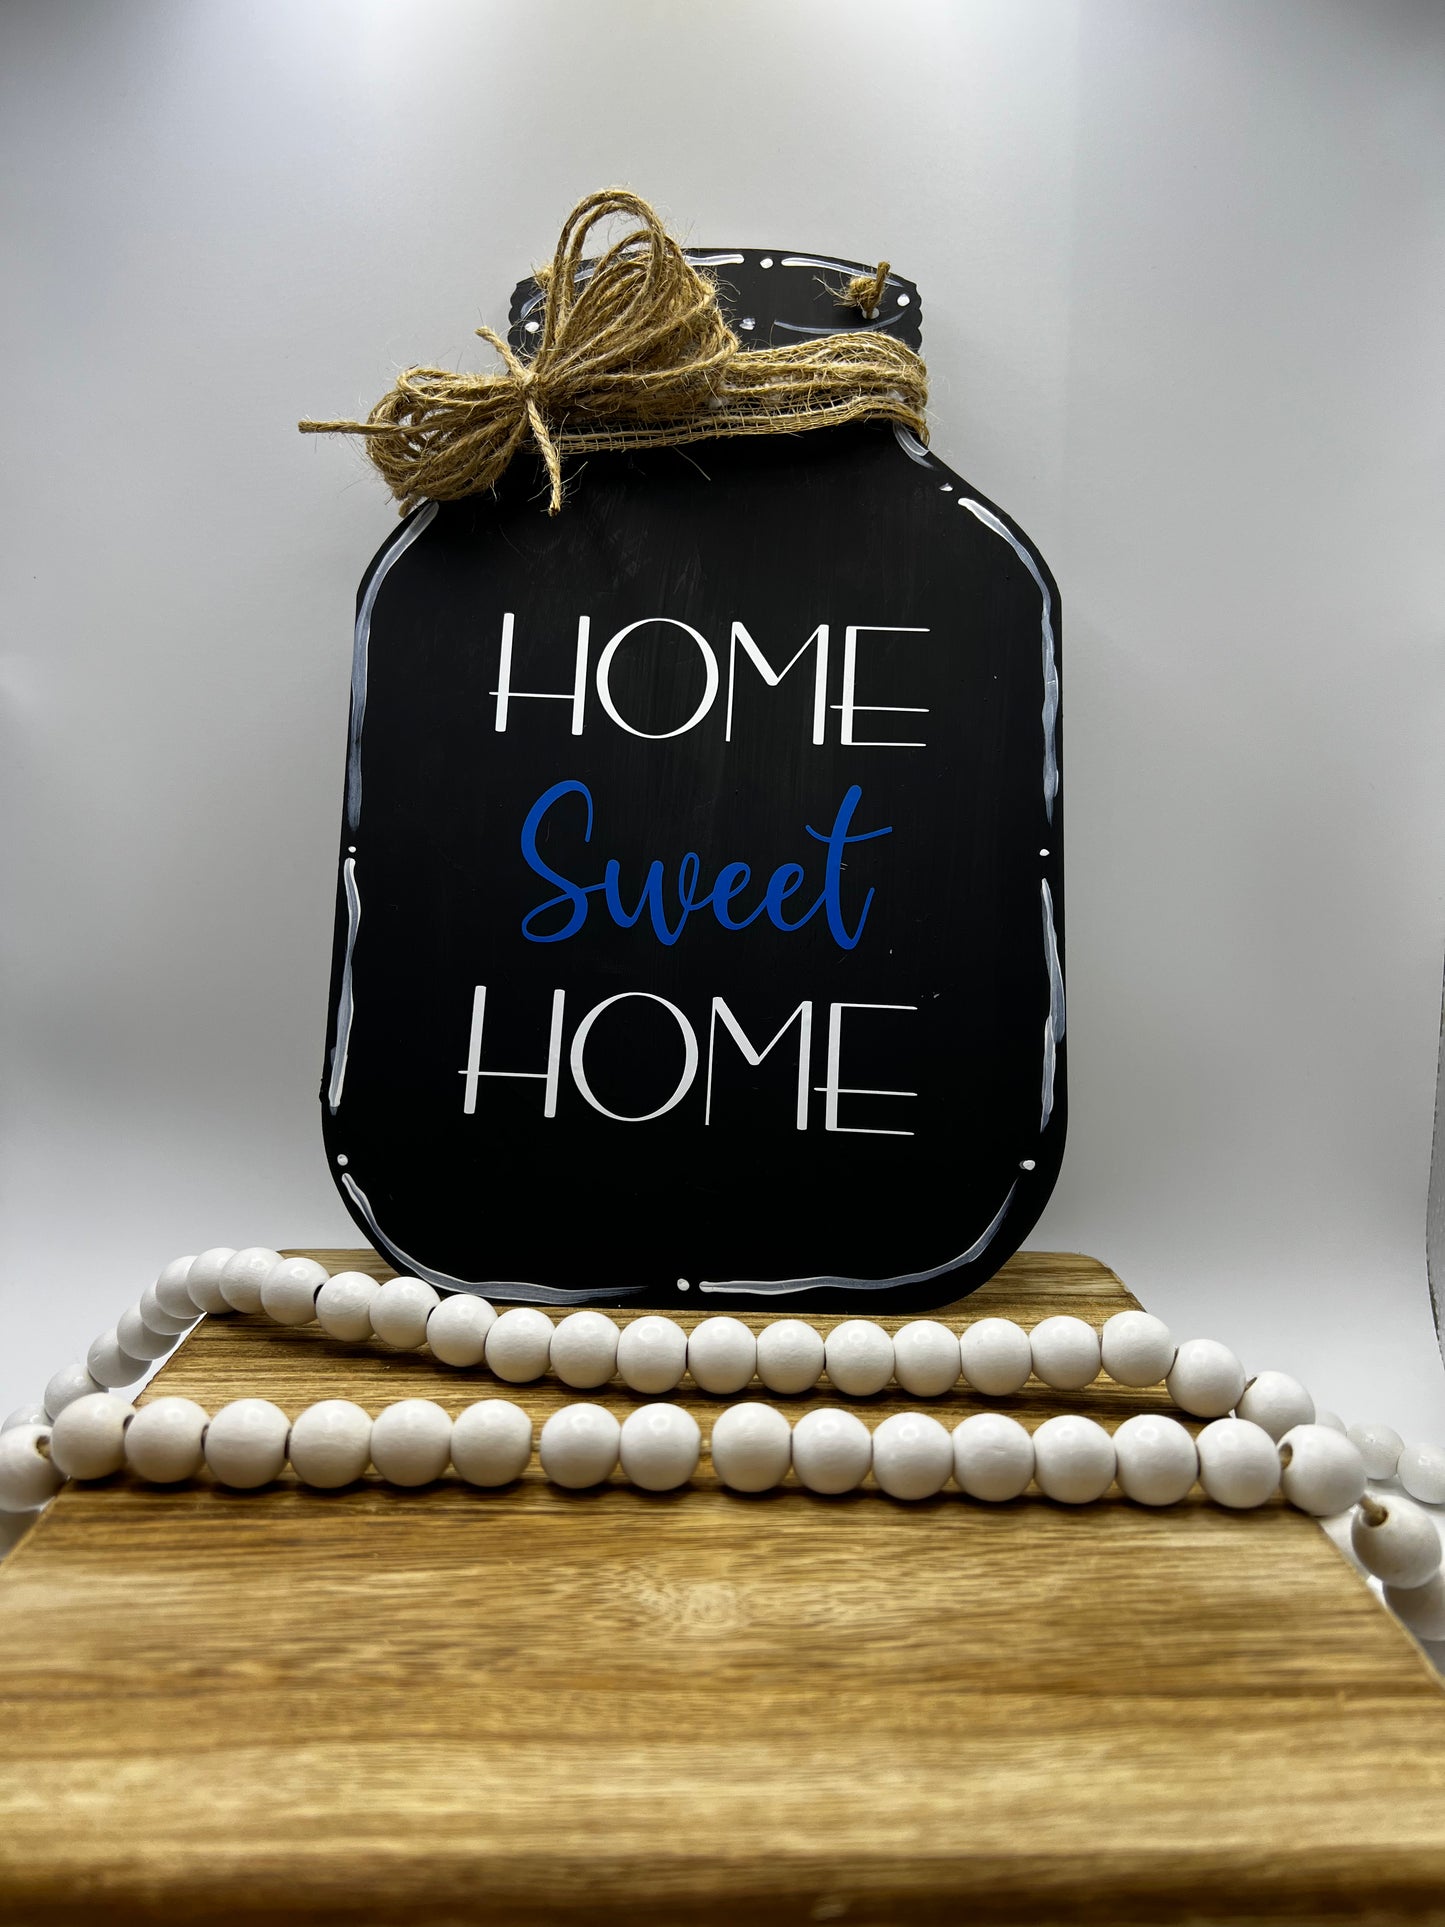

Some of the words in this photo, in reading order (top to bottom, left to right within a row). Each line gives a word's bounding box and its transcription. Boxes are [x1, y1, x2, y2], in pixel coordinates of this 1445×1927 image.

[489, 612, 931, 748] HOME
[520, 779, 893, 951] Sweet
[457, 985, 918, 1136] HOME
